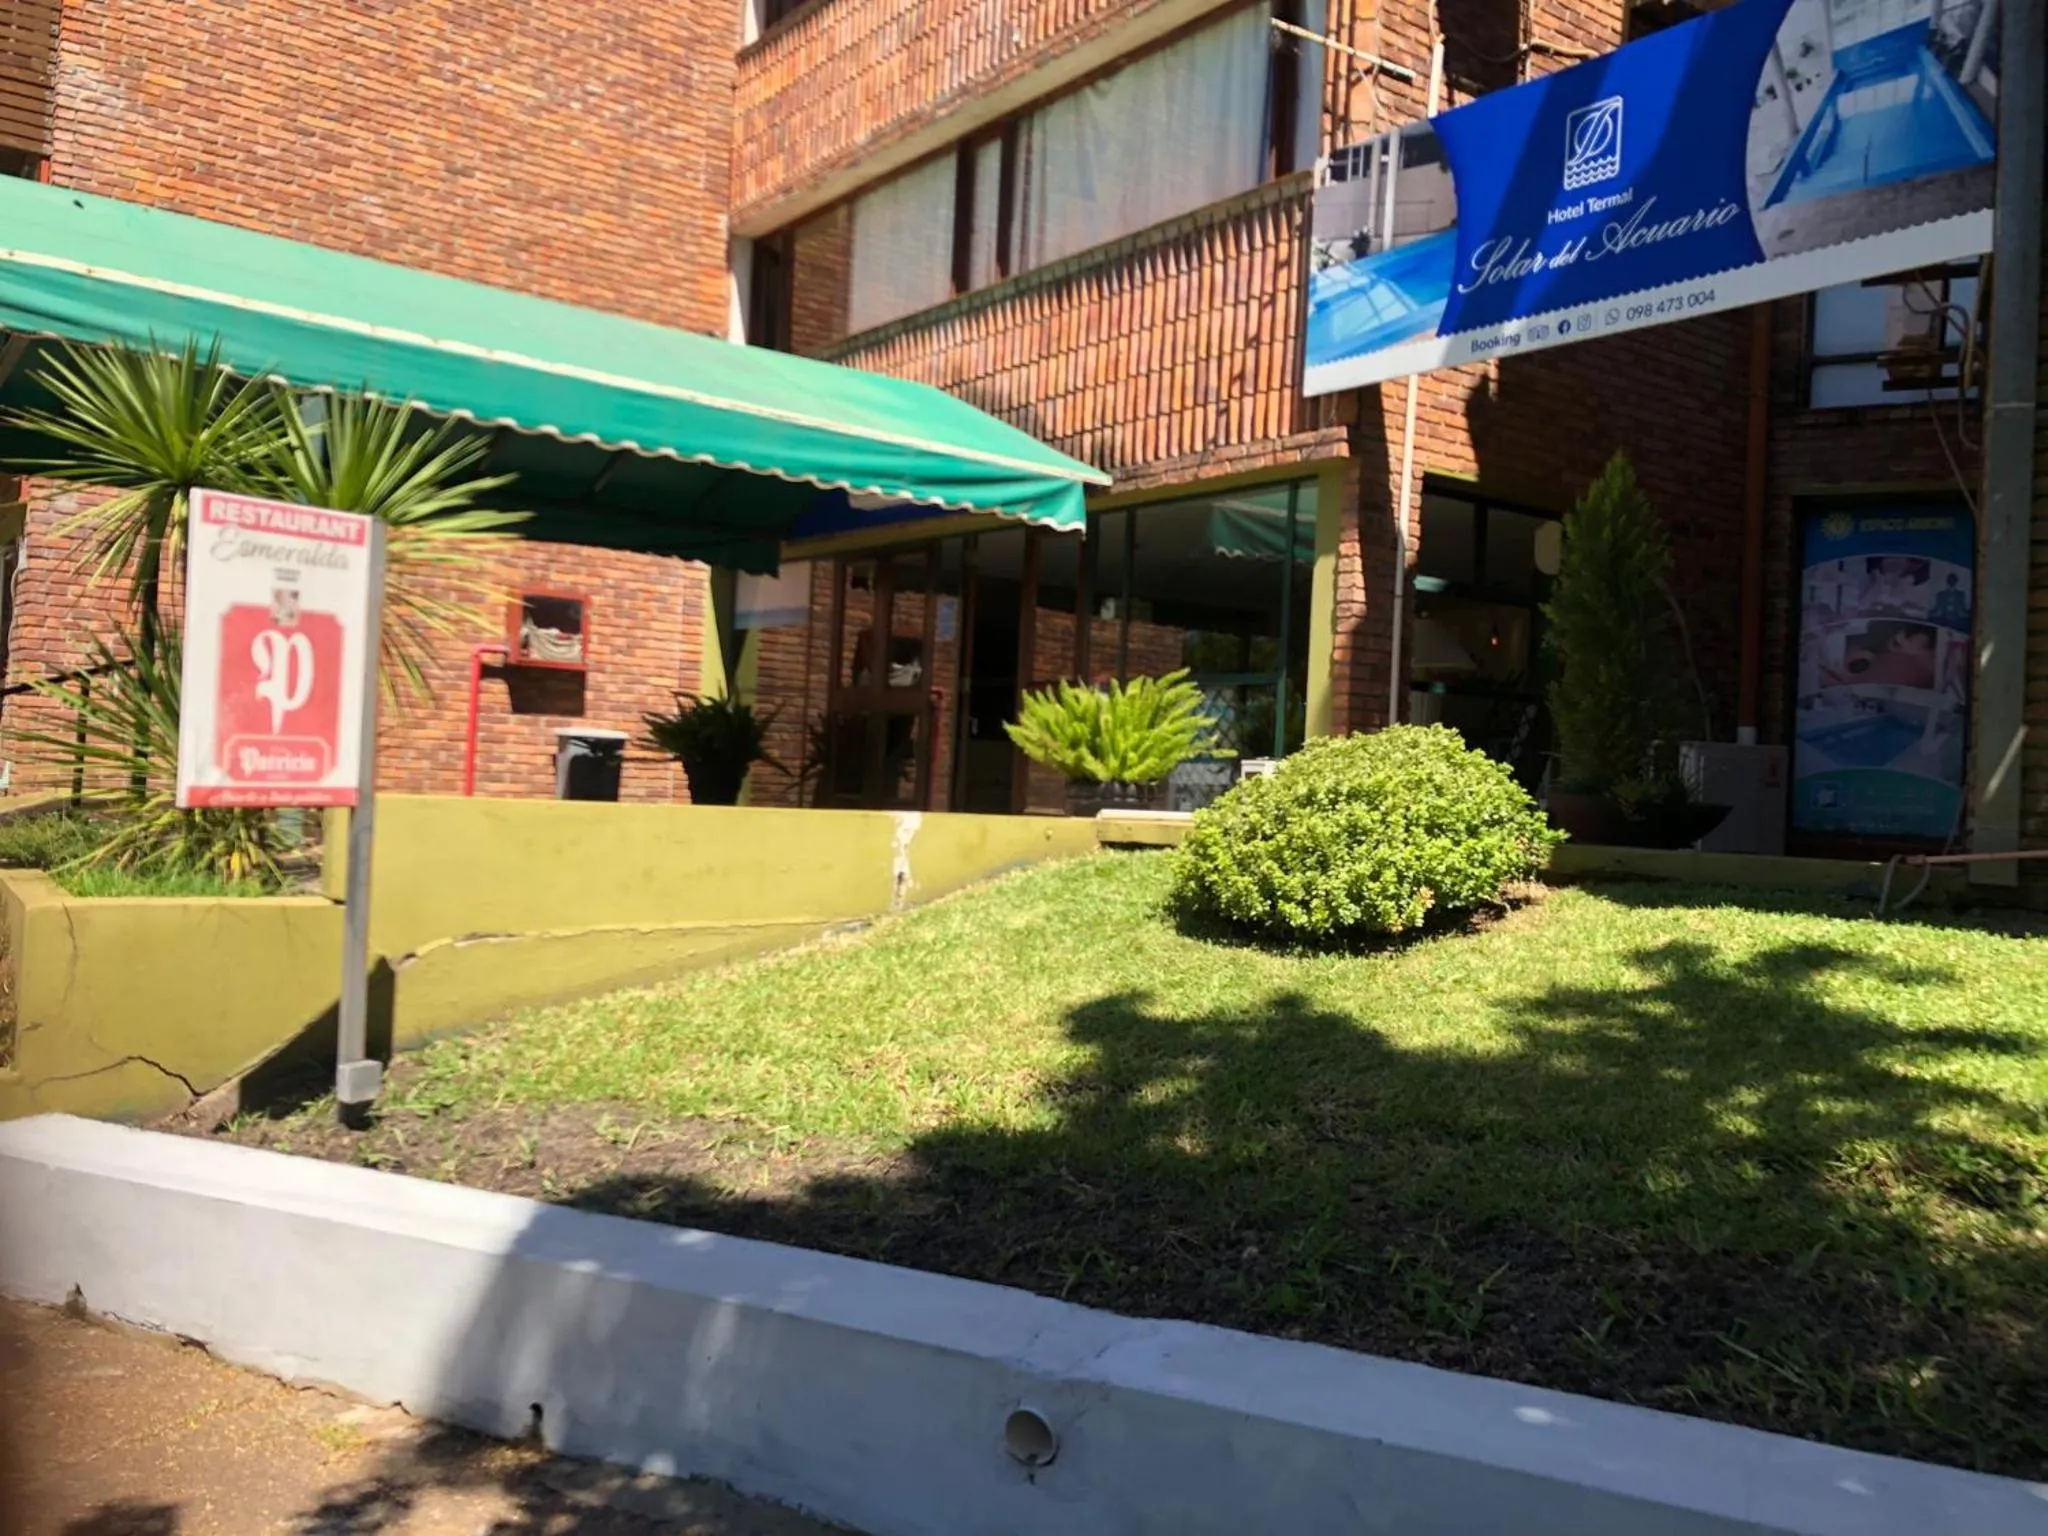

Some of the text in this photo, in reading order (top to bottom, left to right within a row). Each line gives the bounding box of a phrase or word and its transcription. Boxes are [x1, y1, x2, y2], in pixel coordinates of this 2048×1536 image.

[1547, 187, 1634, 226] Hotel Termal
[1458, 196, 1741, 294] Solar del Acuario
[1470, 289, 1716, 353] Booking 098 473 004
[209, 499, 361, 541] RESTAURANT
[209, 522, 349, 570] Esmeralda
